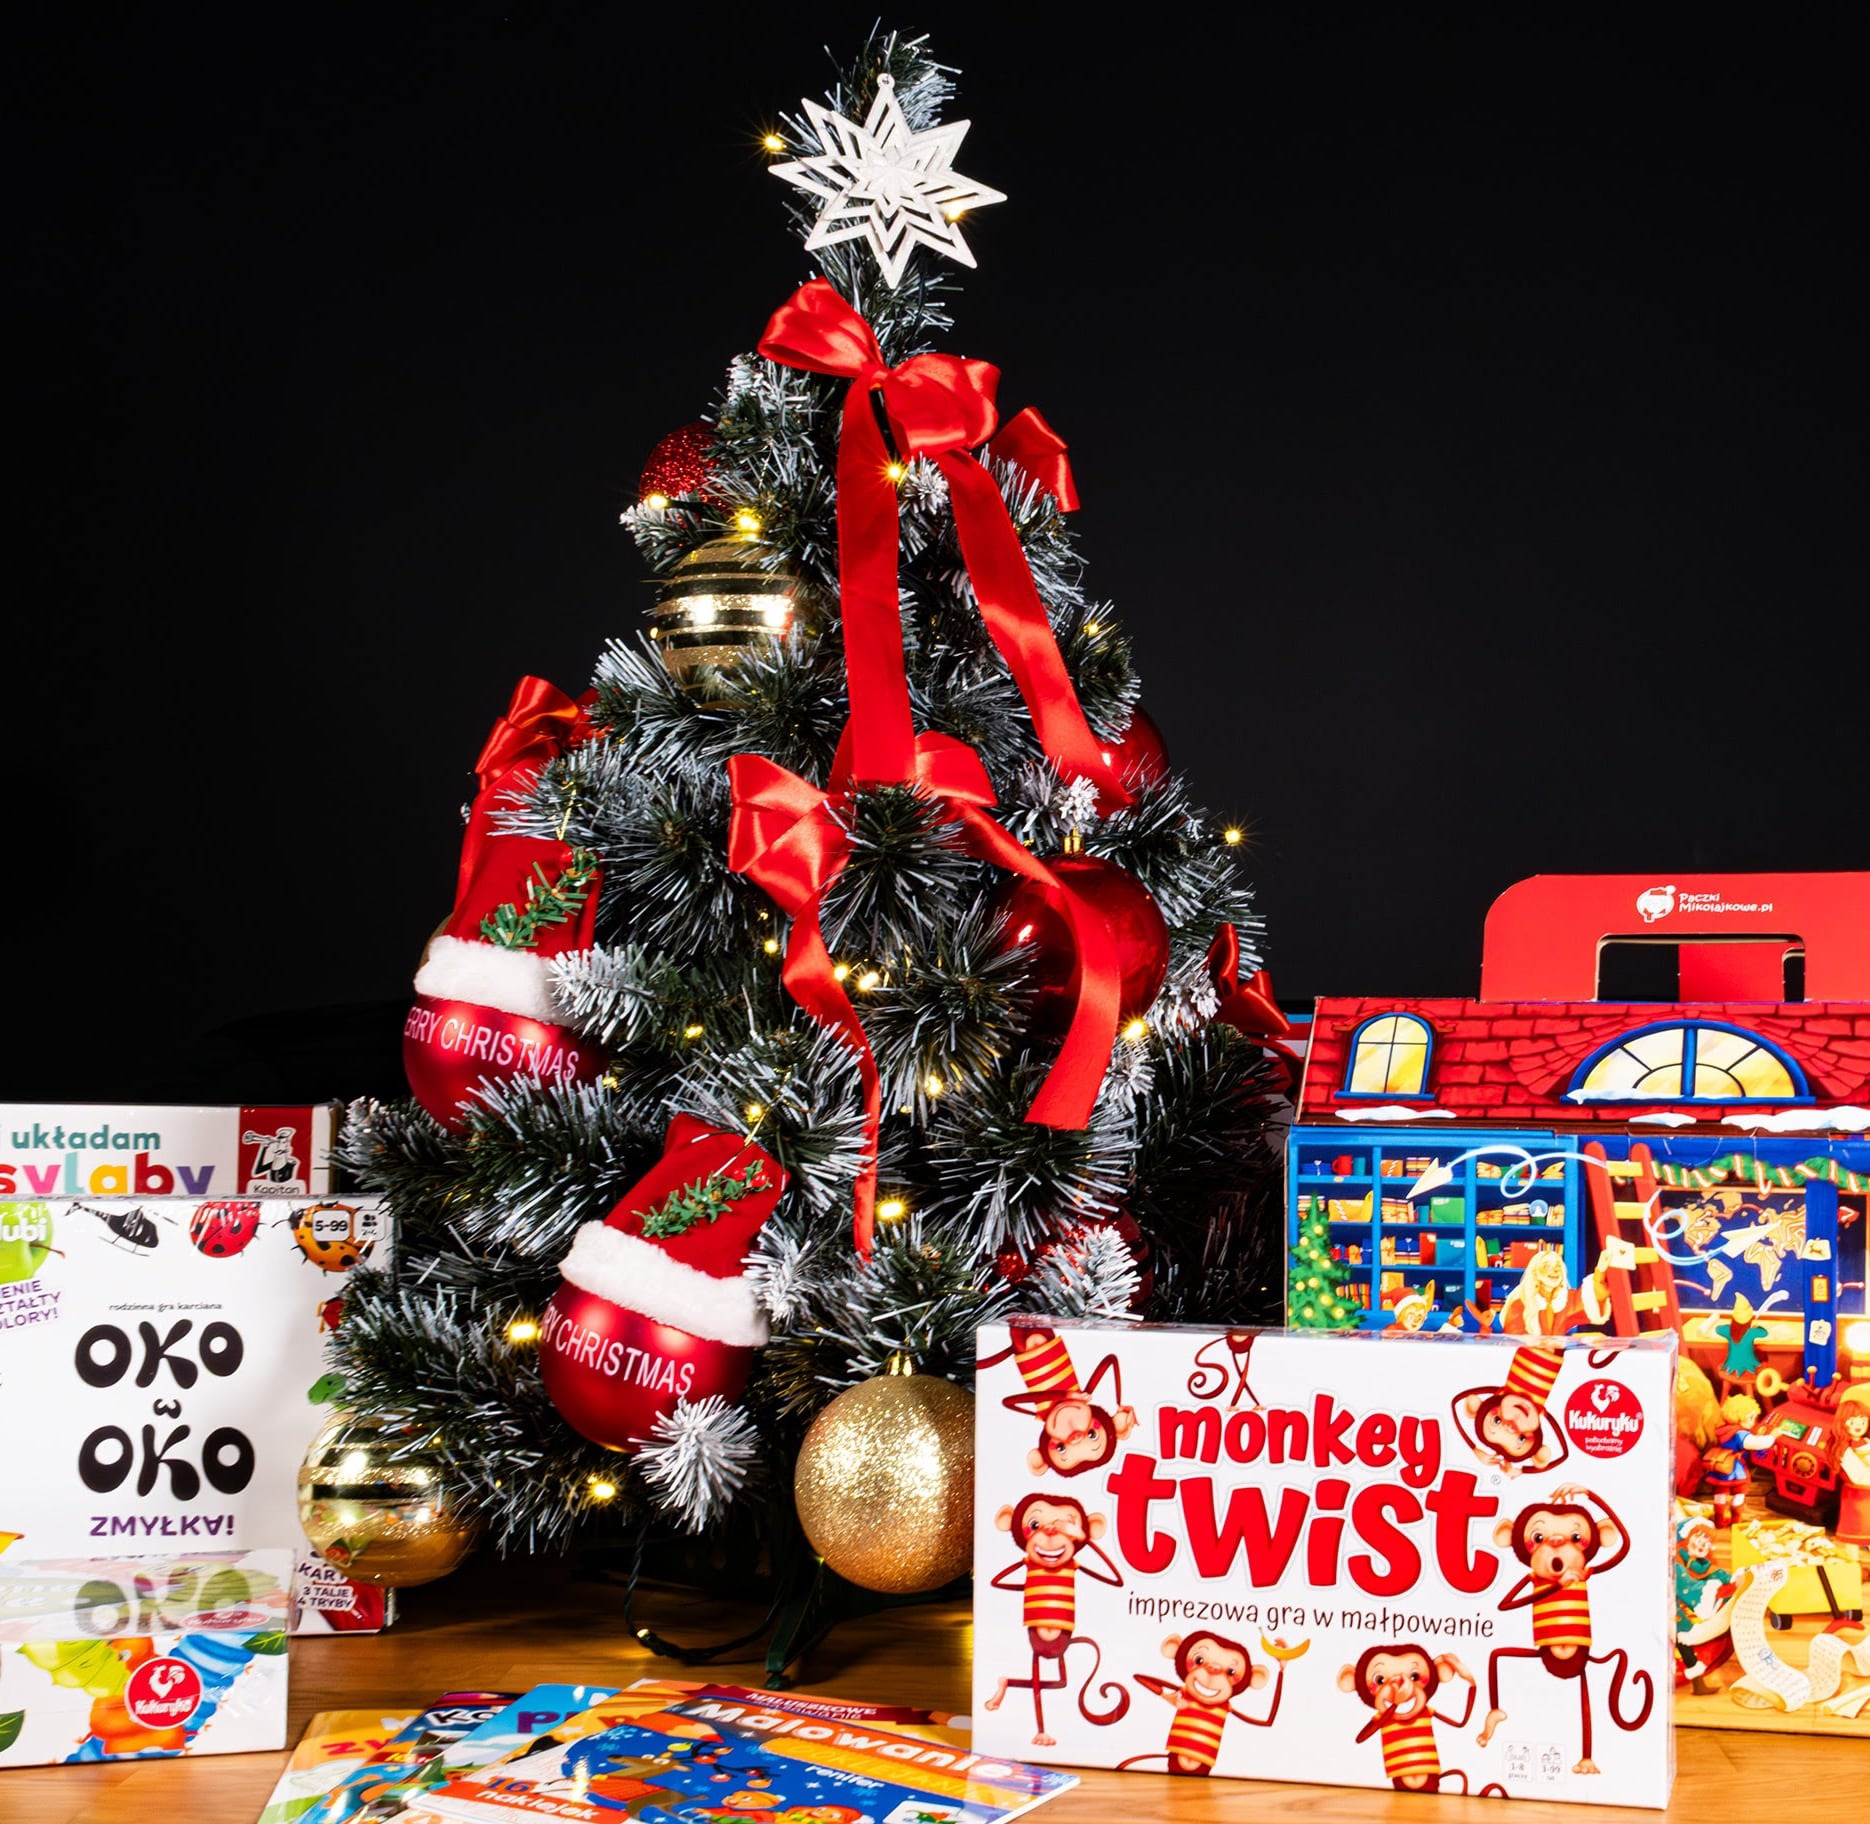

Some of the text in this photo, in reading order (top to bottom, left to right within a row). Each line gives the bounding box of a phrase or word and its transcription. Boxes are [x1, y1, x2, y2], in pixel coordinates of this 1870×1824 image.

[441, 1018, 580, 1081] CHRISTMAS
[11, 1123, 161, 1150] układam
[315, 1220, 348, 1232] 5-99
[157, 1303, 174, 1312] gra
[177, 1301, 223, 1310] karciana
[75, 1318, 244, 1389] OKO
[555, 1318, 696, 1396] CHRISTMAS
[1159, 1394, 1441, 1489] monkey
[79, 1424, 255, 1501] OKO
[1107, 1453, 1500, 1597] twist
[310, 1597, 353, 1609] TRYBY
[315, 1586, 350, 1598] TALIE
[1128, 1591, 1494, 1639] imprezowa gra w małpowanie
[686, 1703, 1014, 1779] Malowanie
[488, 1777, 530, 1793] 16
[804, 1765, 885, 1789] renifer
[475, 1790, 600, 1819] naklejek
